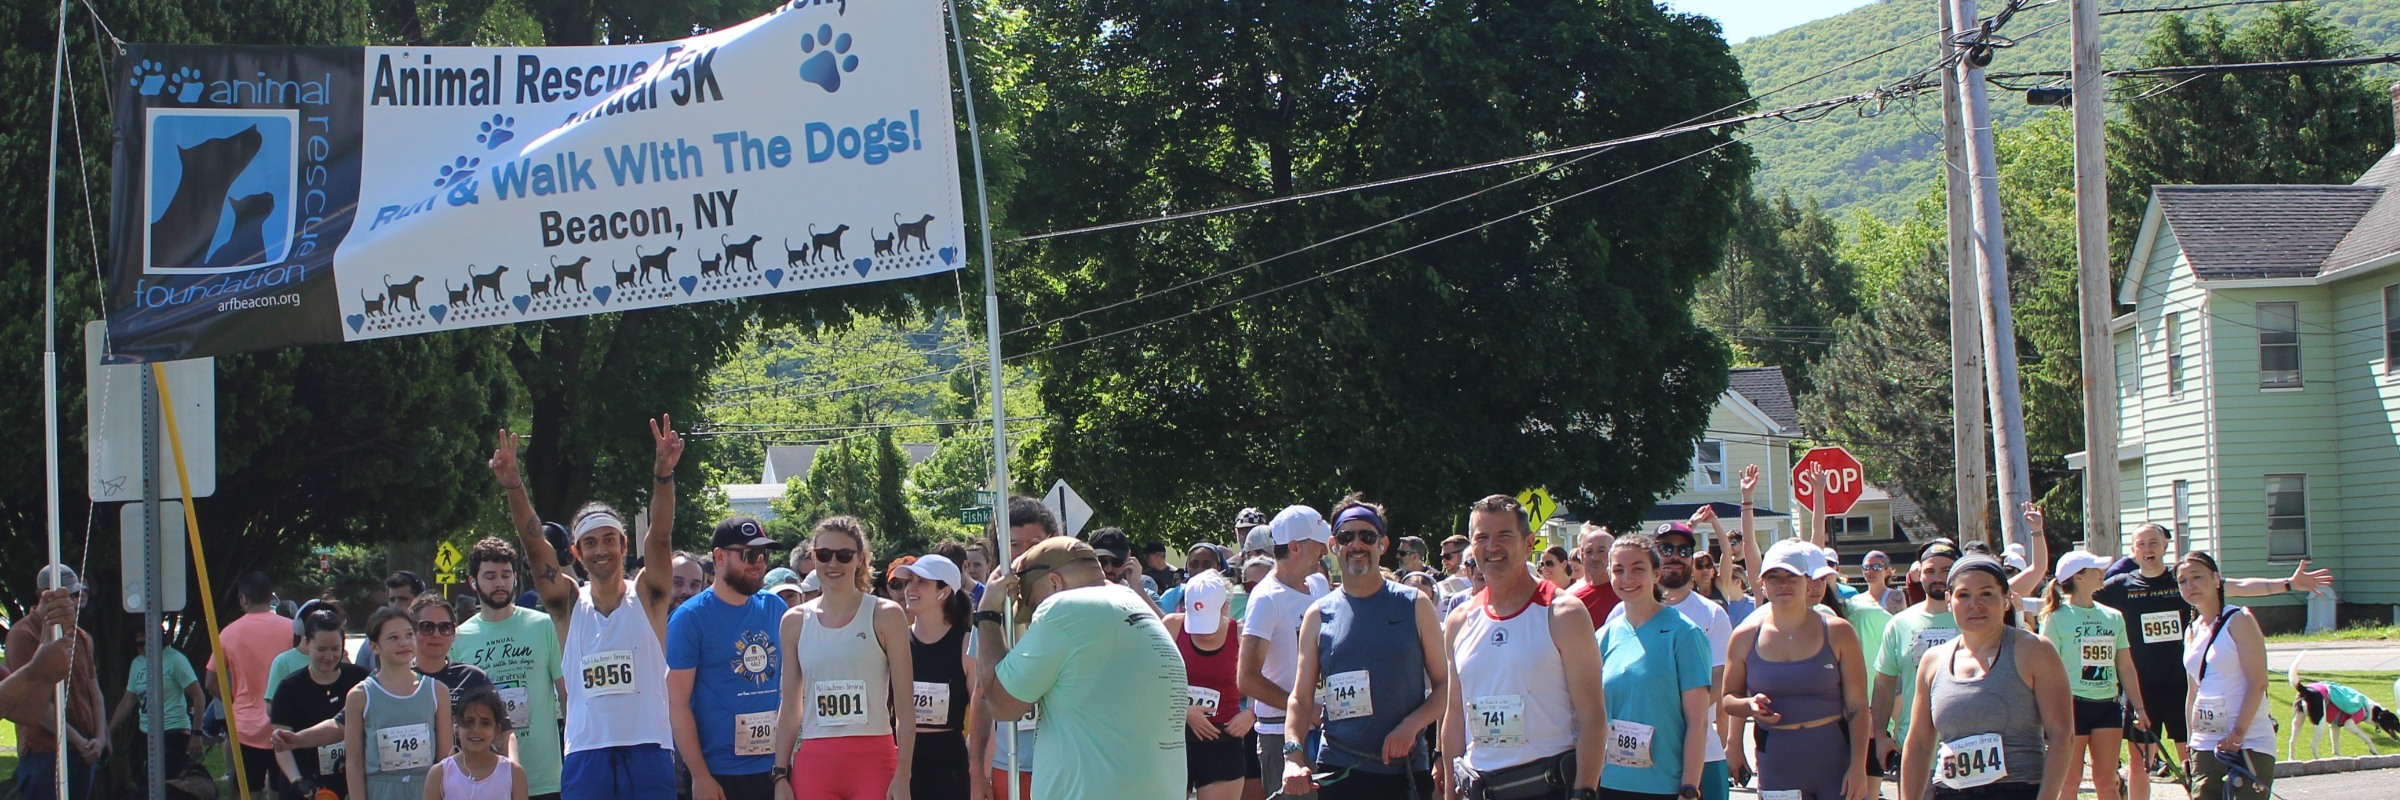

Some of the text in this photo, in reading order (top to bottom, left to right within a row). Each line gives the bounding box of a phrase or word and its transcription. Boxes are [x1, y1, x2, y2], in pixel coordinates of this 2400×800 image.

[370, 54, 649, 106] Animal Rescue
[671, 46, 724, 107] 5K
[209, 72, 331, 106] animal
[446, 177, 480, 207] &
[492, 151, 597, 201] Walk
[713, 130, 792, 175] The
[804, 109, 923, 165] Dogs!
[294, 115, 329, 258] rescue
[540, 189, 739, 247] Beacon, NY
[133, 264, 305, 308] foundation
[218, 293, 301, 313] arfbeacon.org
[1798, 467, 1858, 496] SOP
[2127, 591, 2147, 599] NEW
[2095, 626, 2115, 637] Run
[2143, 619, 2180, 637] 5959
[486, 637, 515, 646] ANNUAL
[502, 643, 533, 658] Run
[2082, 645, 2113, 660] 5958
[495, 671, 527, 682] animal
[582, 663, 632, 689] 5956
[913, 694, 933, 708] 781
[1334, 685, 1356, 701] 744
[817, 693, 864, 717] 5901
[1482, 711, 1505, 727] 741
[2198, 709, 2214, 720] 719
[750, 724, 770, 738] 780
[393, 737, 419, 753] 748
[1618, 734, 1637, 750] 689
[330, 748, 346, 760] 80
[1943, 746, 2002, 779] 5944
